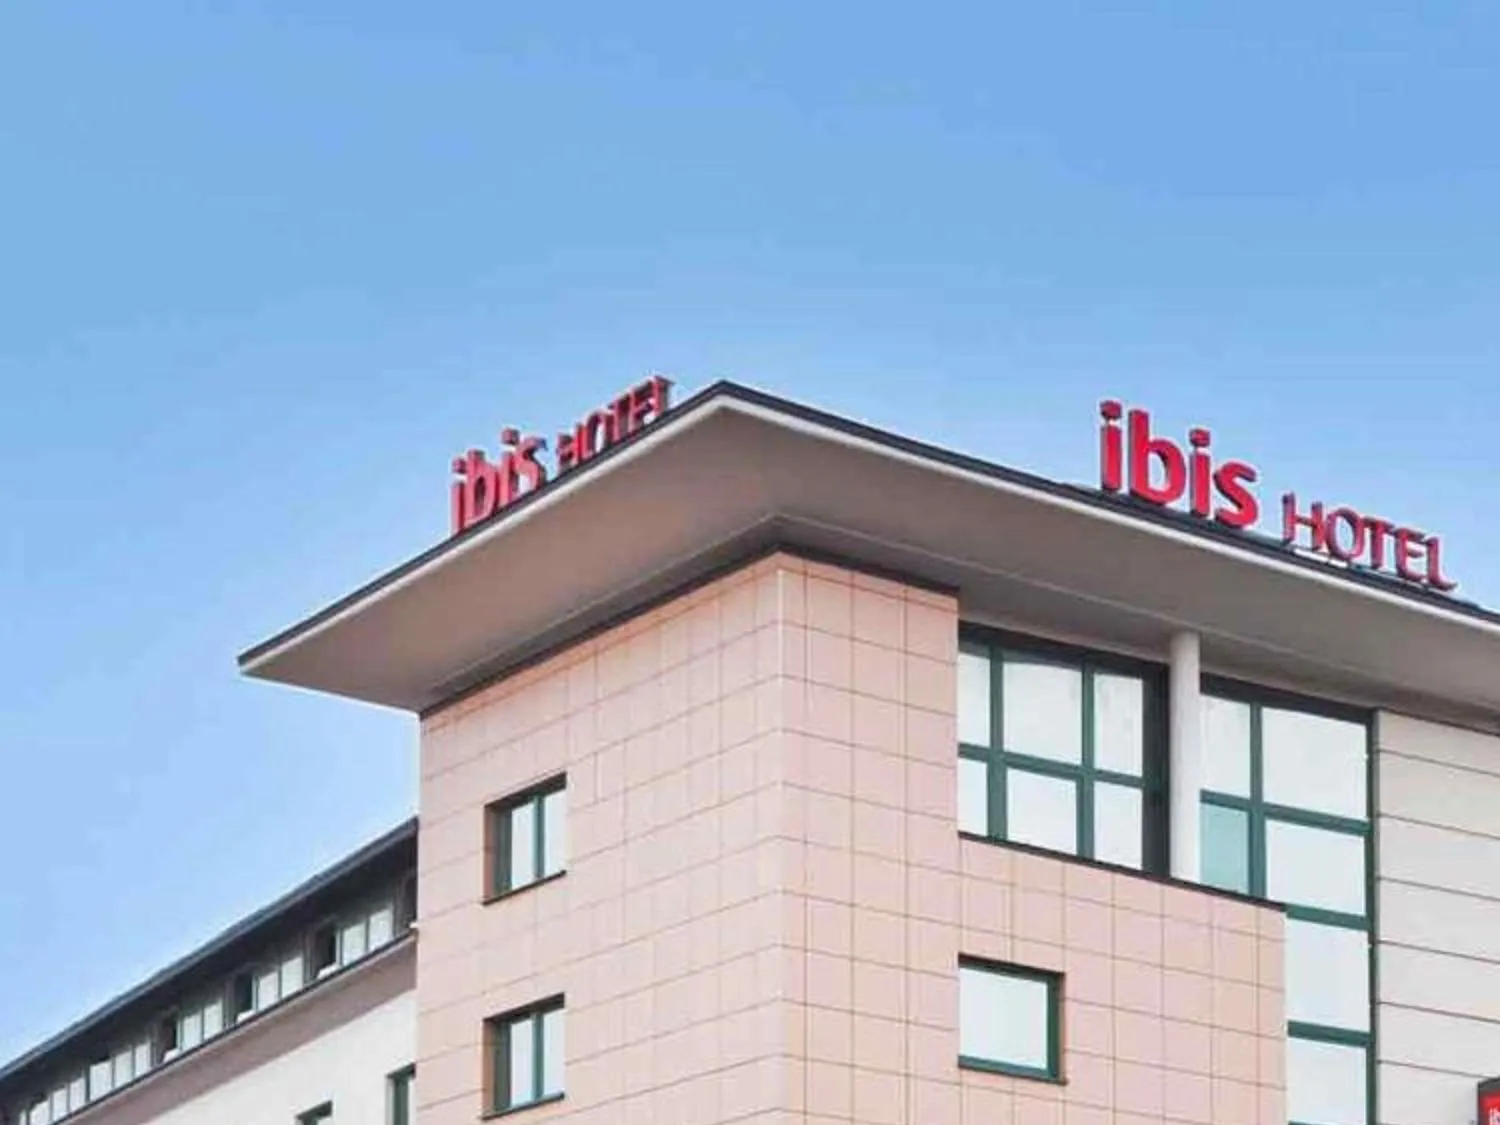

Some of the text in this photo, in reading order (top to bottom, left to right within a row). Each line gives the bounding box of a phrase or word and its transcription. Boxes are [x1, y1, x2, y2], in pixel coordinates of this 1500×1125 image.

[452, 427, 546, 535] ibis
[1100, 400, 1456, 590] ibis HOTEL
